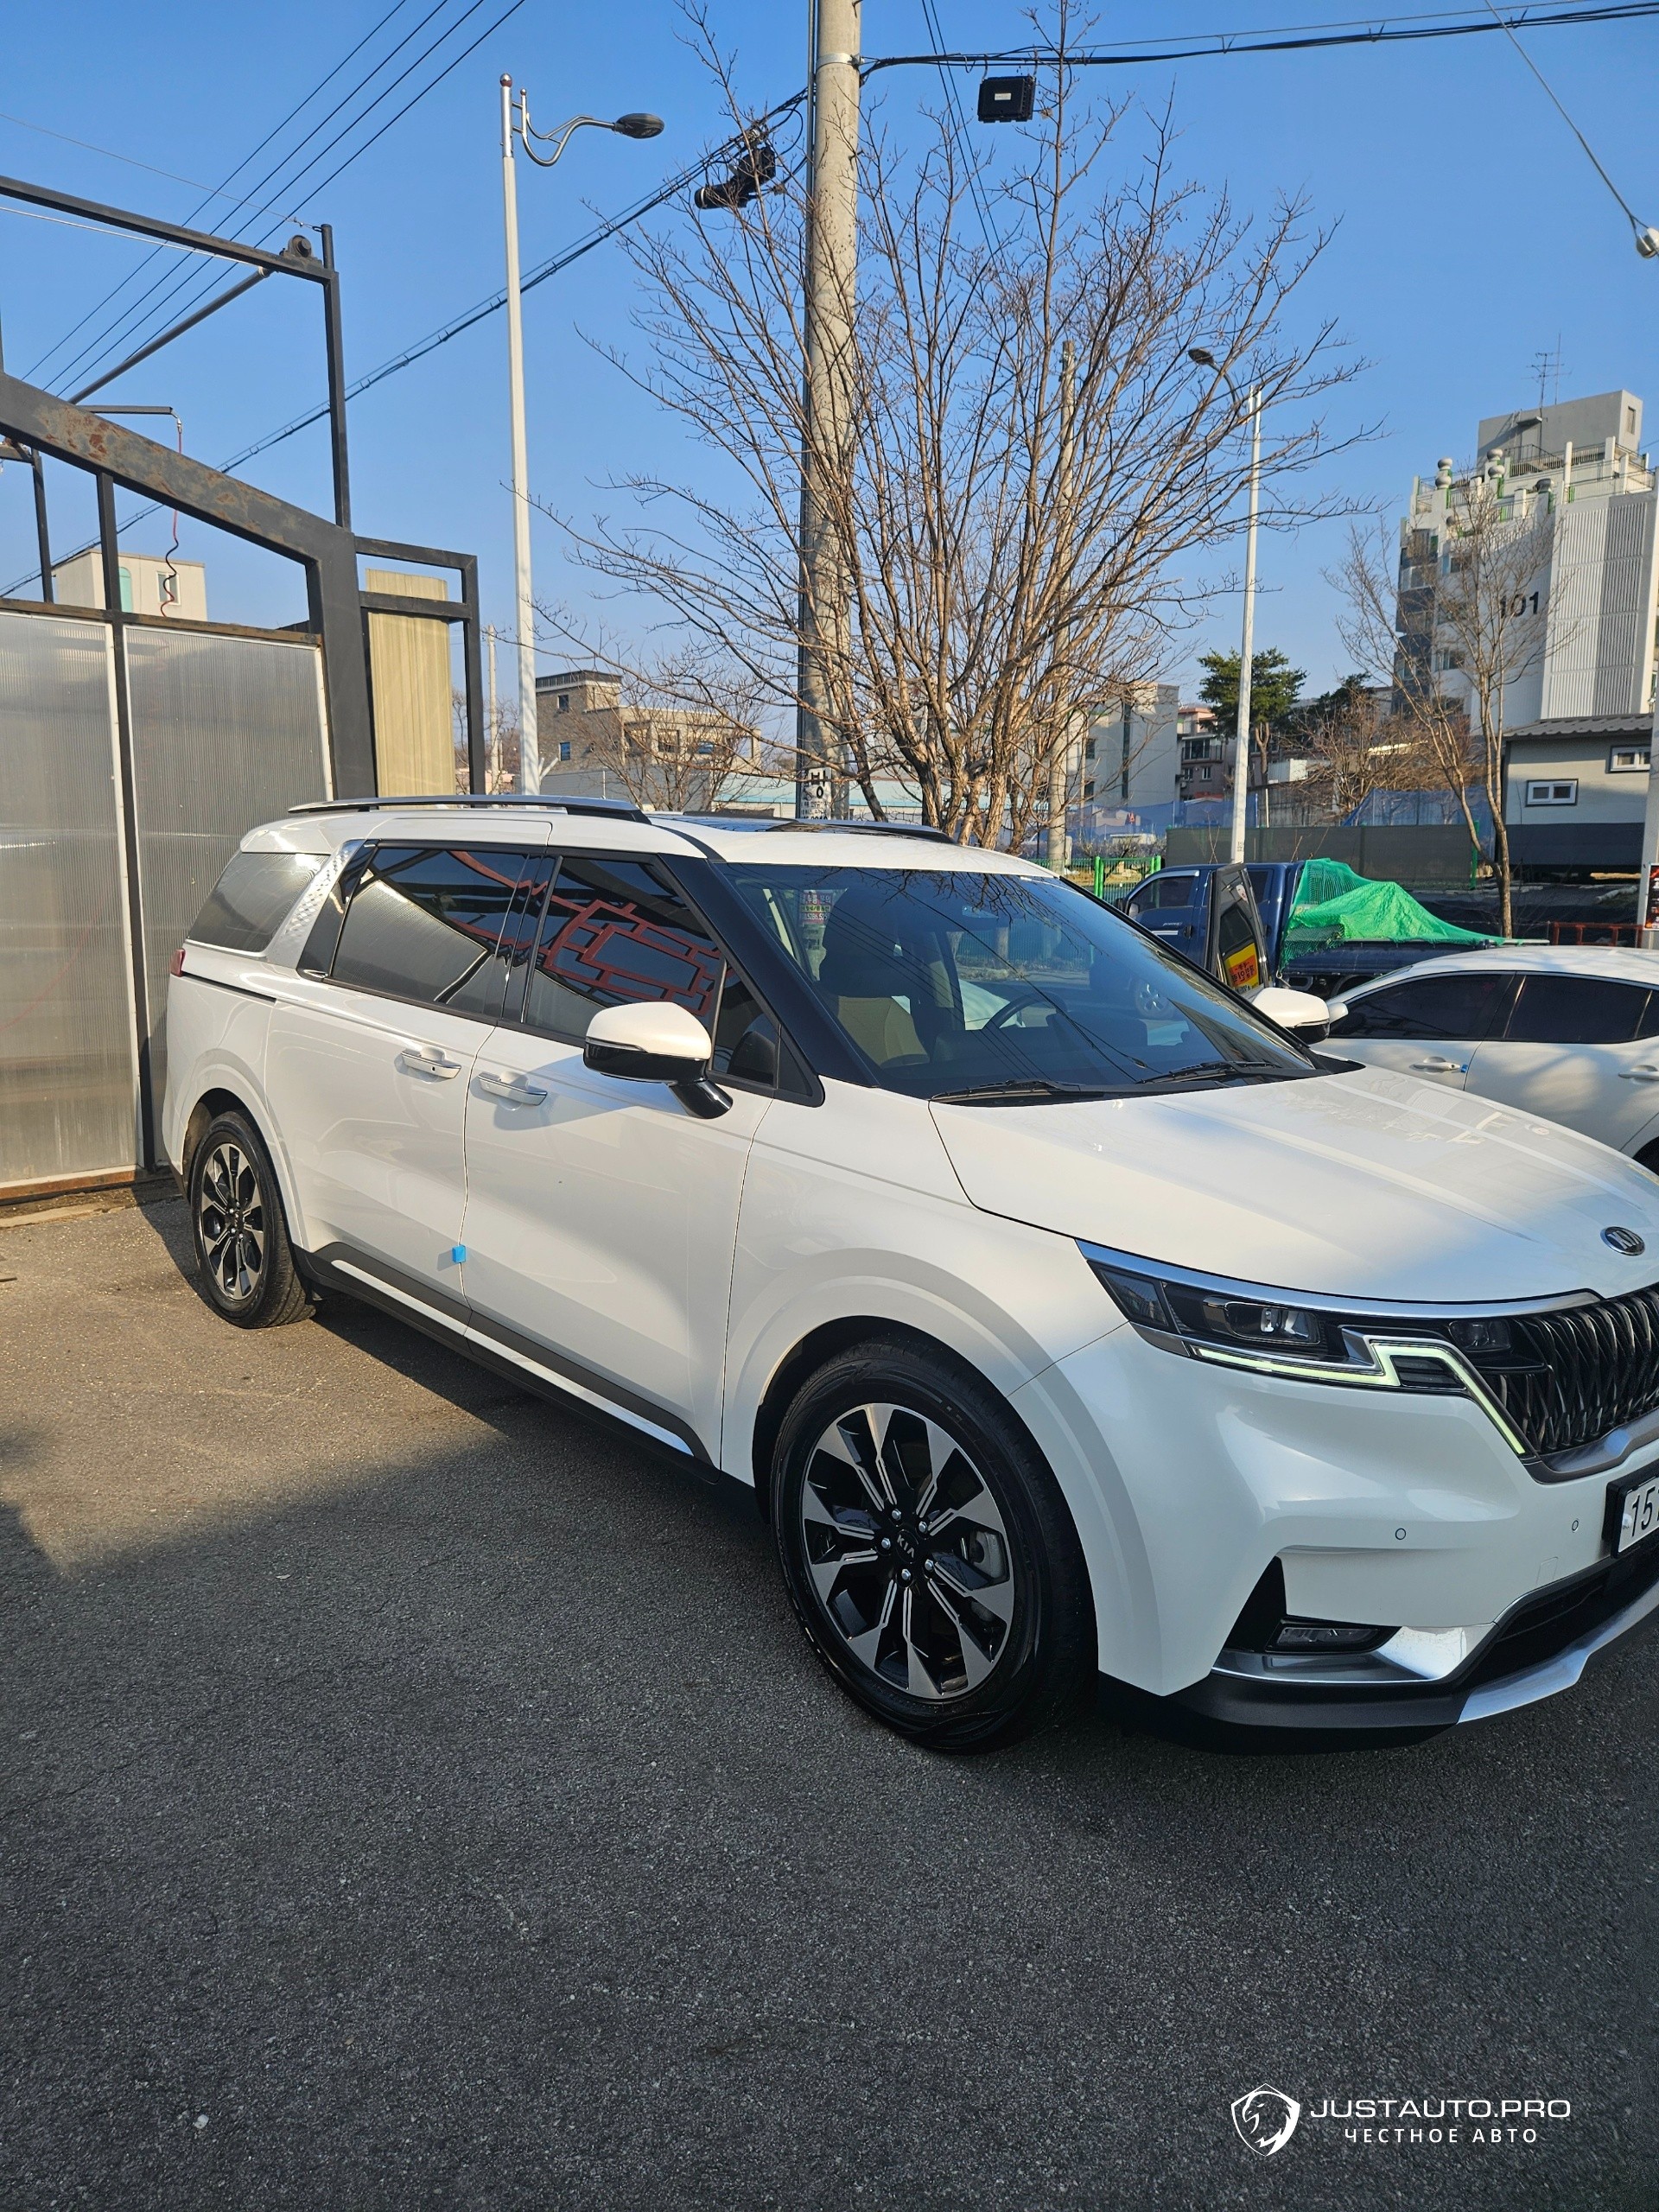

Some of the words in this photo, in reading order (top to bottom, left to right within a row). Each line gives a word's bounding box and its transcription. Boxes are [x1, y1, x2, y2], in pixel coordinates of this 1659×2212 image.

[1500, 591, 1539, 619] 101
[1631, 1485, 1659, 1537] 15
[896, 1534, 915, 1559] KIA
